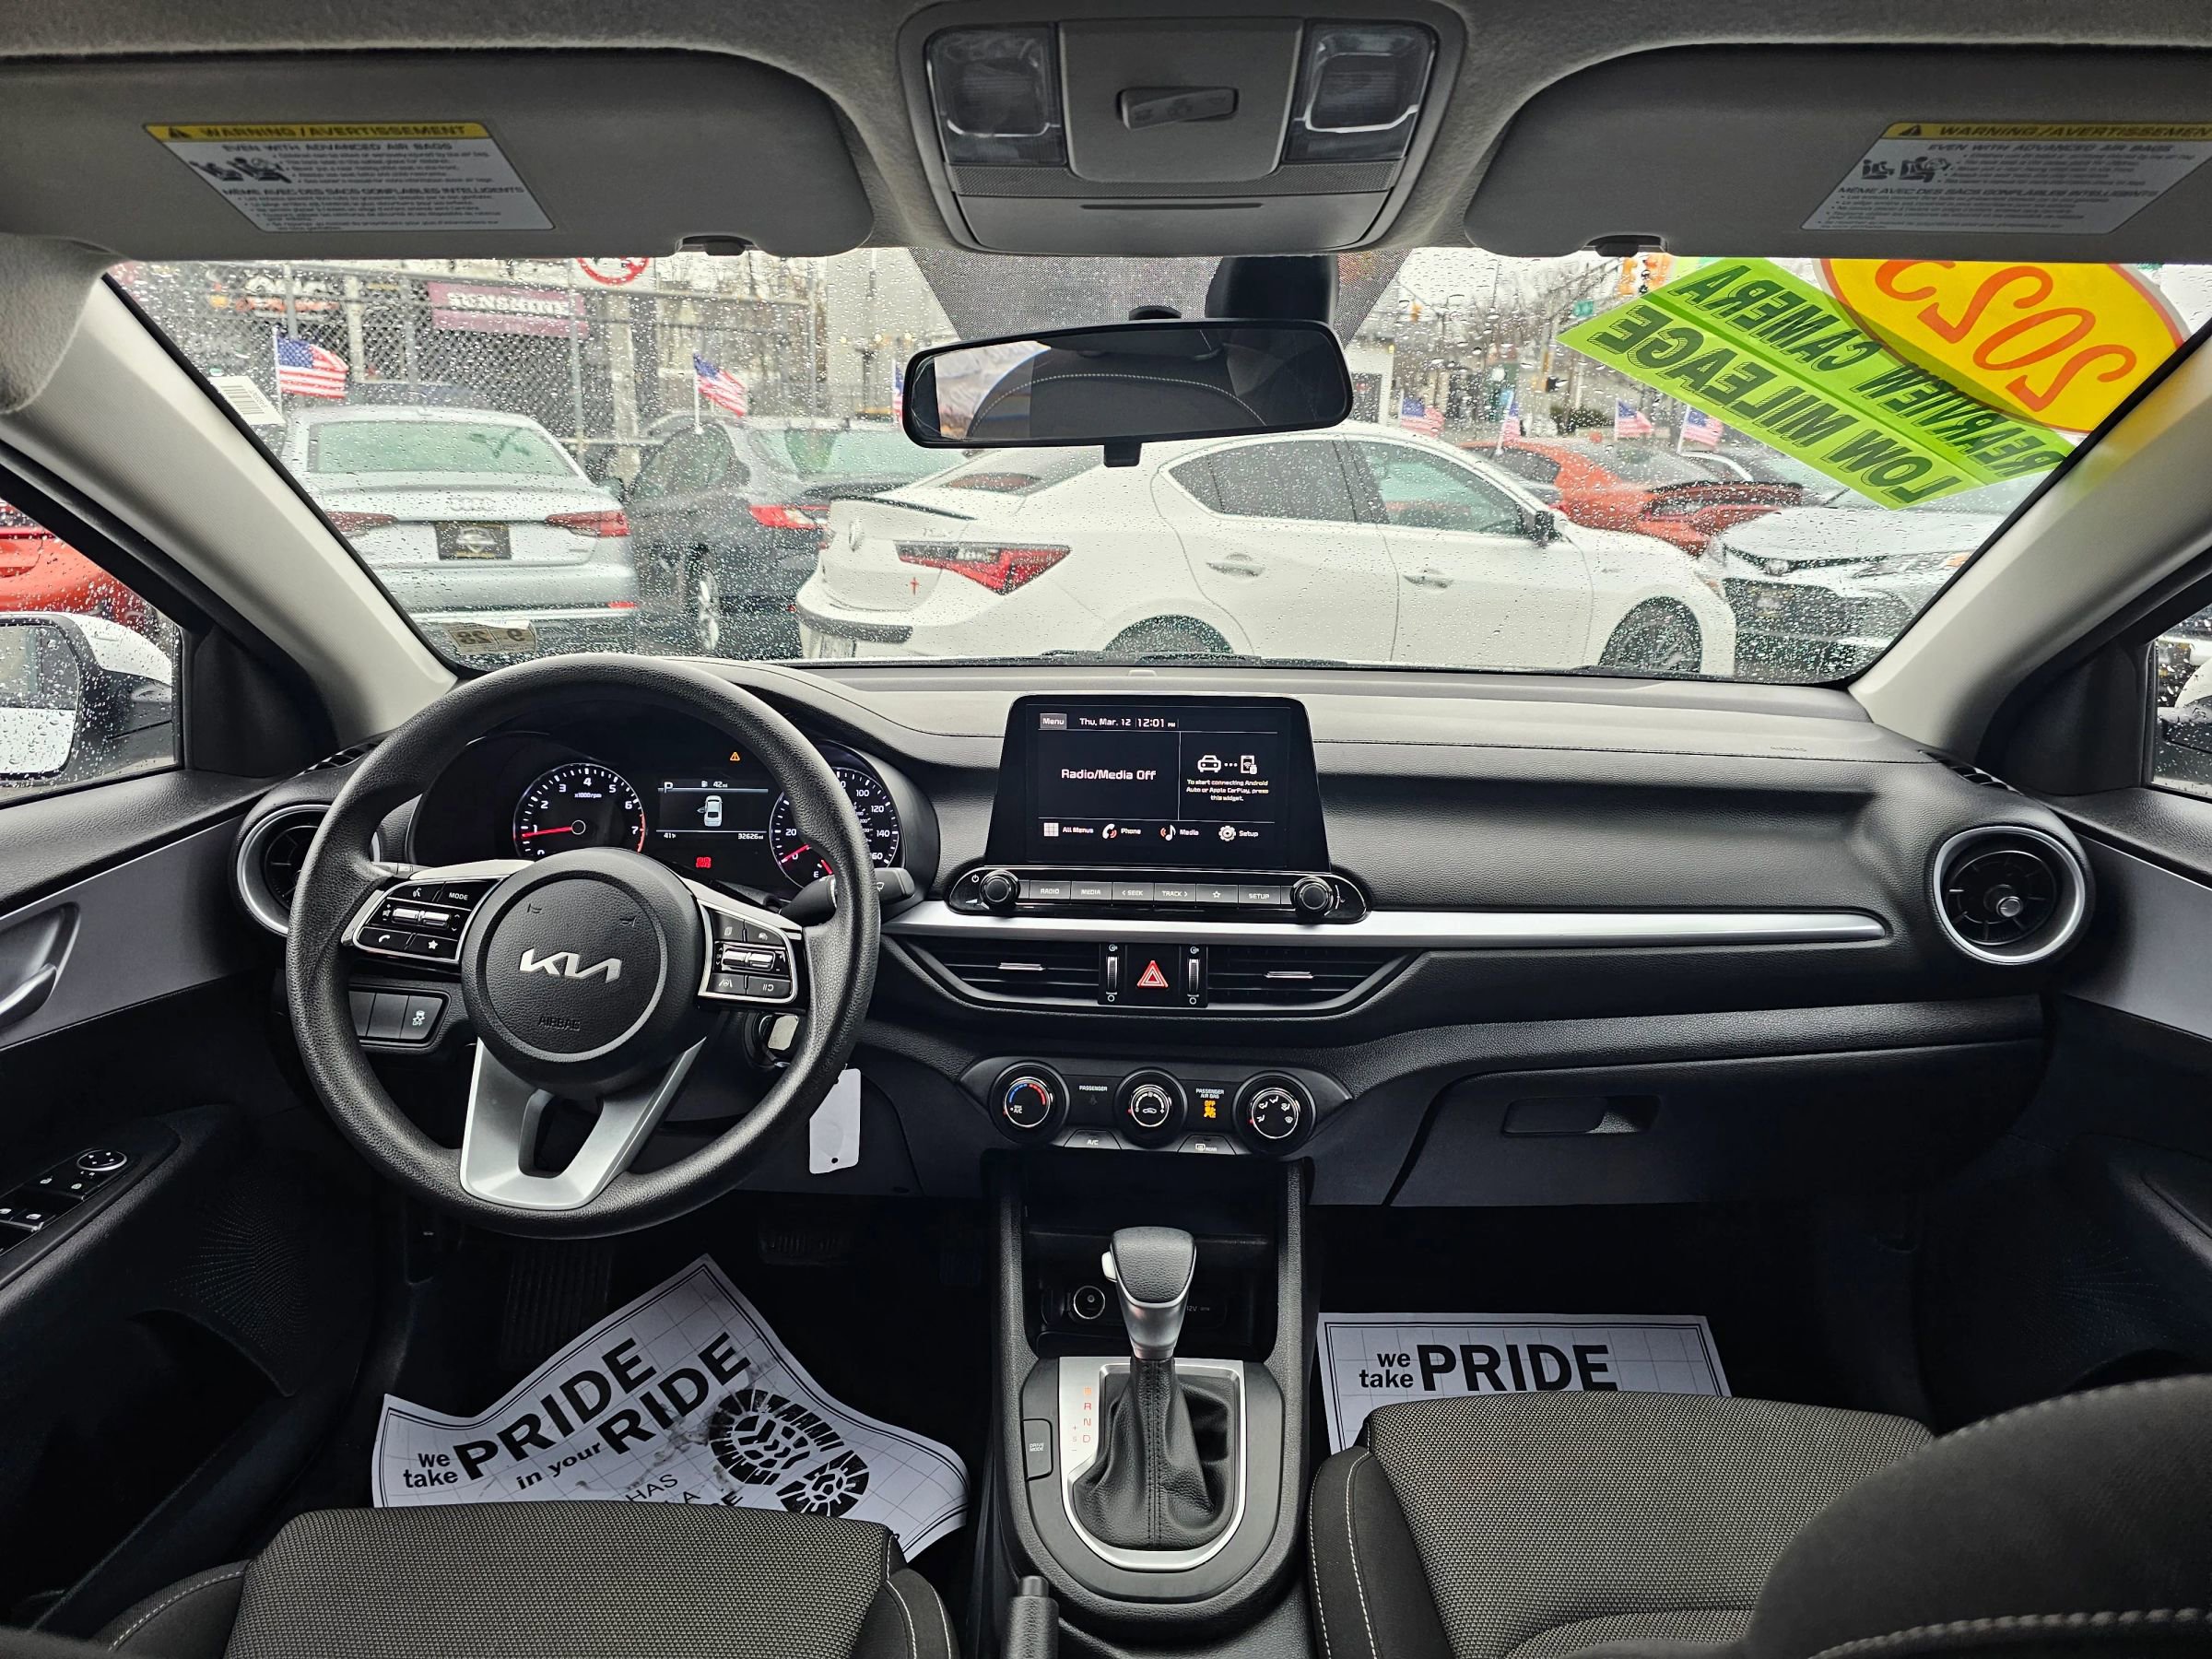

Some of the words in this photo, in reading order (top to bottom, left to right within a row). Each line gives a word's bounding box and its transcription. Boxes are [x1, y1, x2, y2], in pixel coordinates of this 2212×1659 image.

[1939, 125, 2038, 137] WARNING
[2051, 127, 2212, 137] AVERTISSEMEN
[1042, 717, 1065, 725] Menu
[1099, 718, 1119, 726] Mar.
[1121, 718, 1132, 726] 12
[1137, 718, 1165, 728] 12:01
[1061, 768, 1134, 781] Radio/Media
[1135, 770, 1157, 781] Off
[582, 777, 593, 786] 4
[559, 783, 567, 793] 3
[608, 784, 617, 793] 5
[664, 782, 674, 794] P
[855, 789, 870, 797] 100
[540, 800, 549, 809] 2
[625, 801, 633, 810] 6
[871, 805, 885, 813] 120
[631, 826, 639, 835] 7
[876, 830, 890, 838] 140
[448, 891, 469, 900] MODE
[537, 1016, 581, 1031] AIRBAG
[1376, 1352, 1411, 1368] we
[1417, 1344, 1618, 1392] PRIDE
[1359, 1370, 1414, 1388] take
[595, 1332, 751, 1455] RIDE
[453, 1337, 657, 1481] PRIDE
[1084, 1402, 1092, 1410] R
[1083, 1418, 1091, 1427] N
[1082, 1434, 1091, 1443] D
[417, 1452, 452, 1468] we
[515, 1472, 543, 1491] in
[546, 1441, 602, 1479] your
[403, 1467, 459, 1489] take
[625, 1474, 678, 1502] HAS
